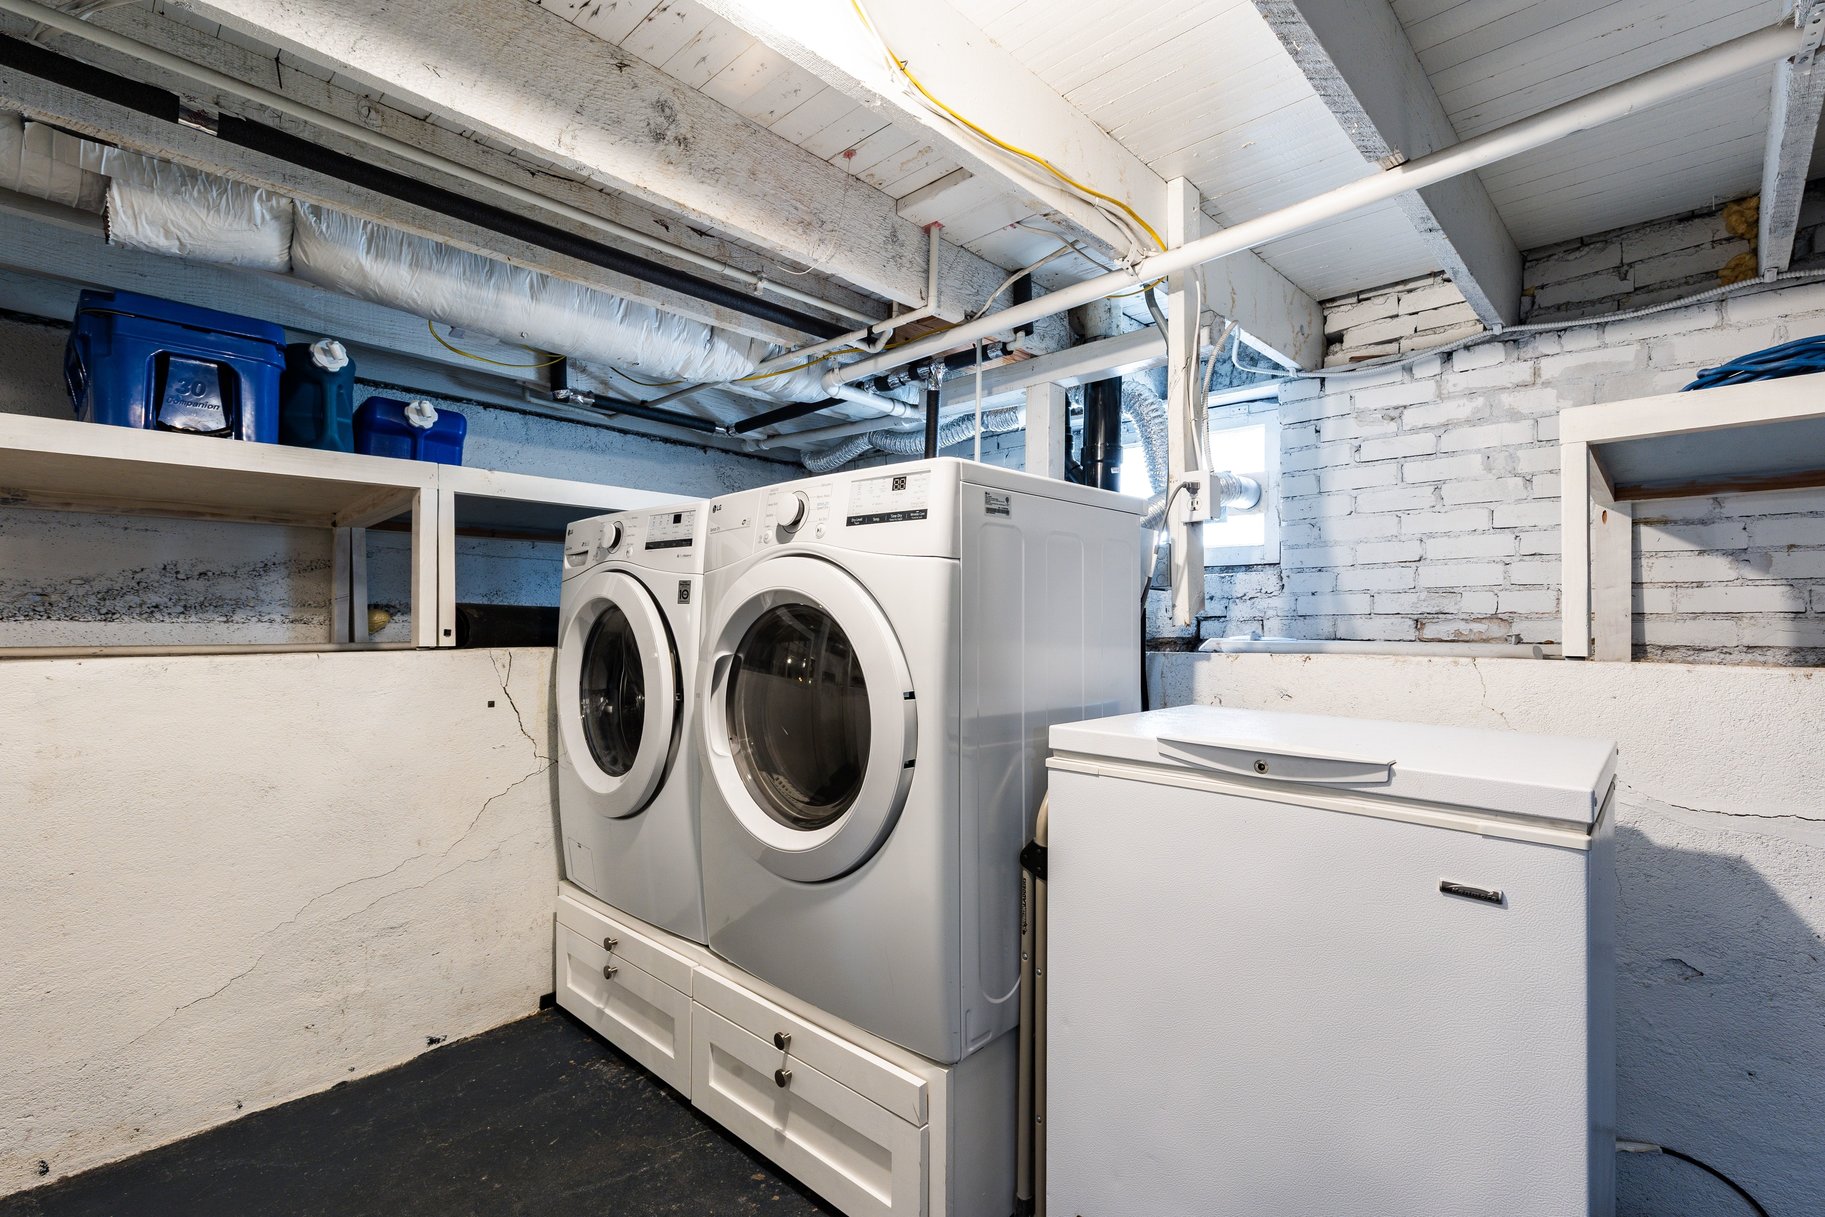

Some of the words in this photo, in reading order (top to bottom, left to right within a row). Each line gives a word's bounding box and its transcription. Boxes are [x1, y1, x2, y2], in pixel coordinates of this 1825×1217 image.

[175, 378, 206, 399] 30
[167, 396, 220, 410] Companion
[1452, 887, 1496, 901] Kenmore
